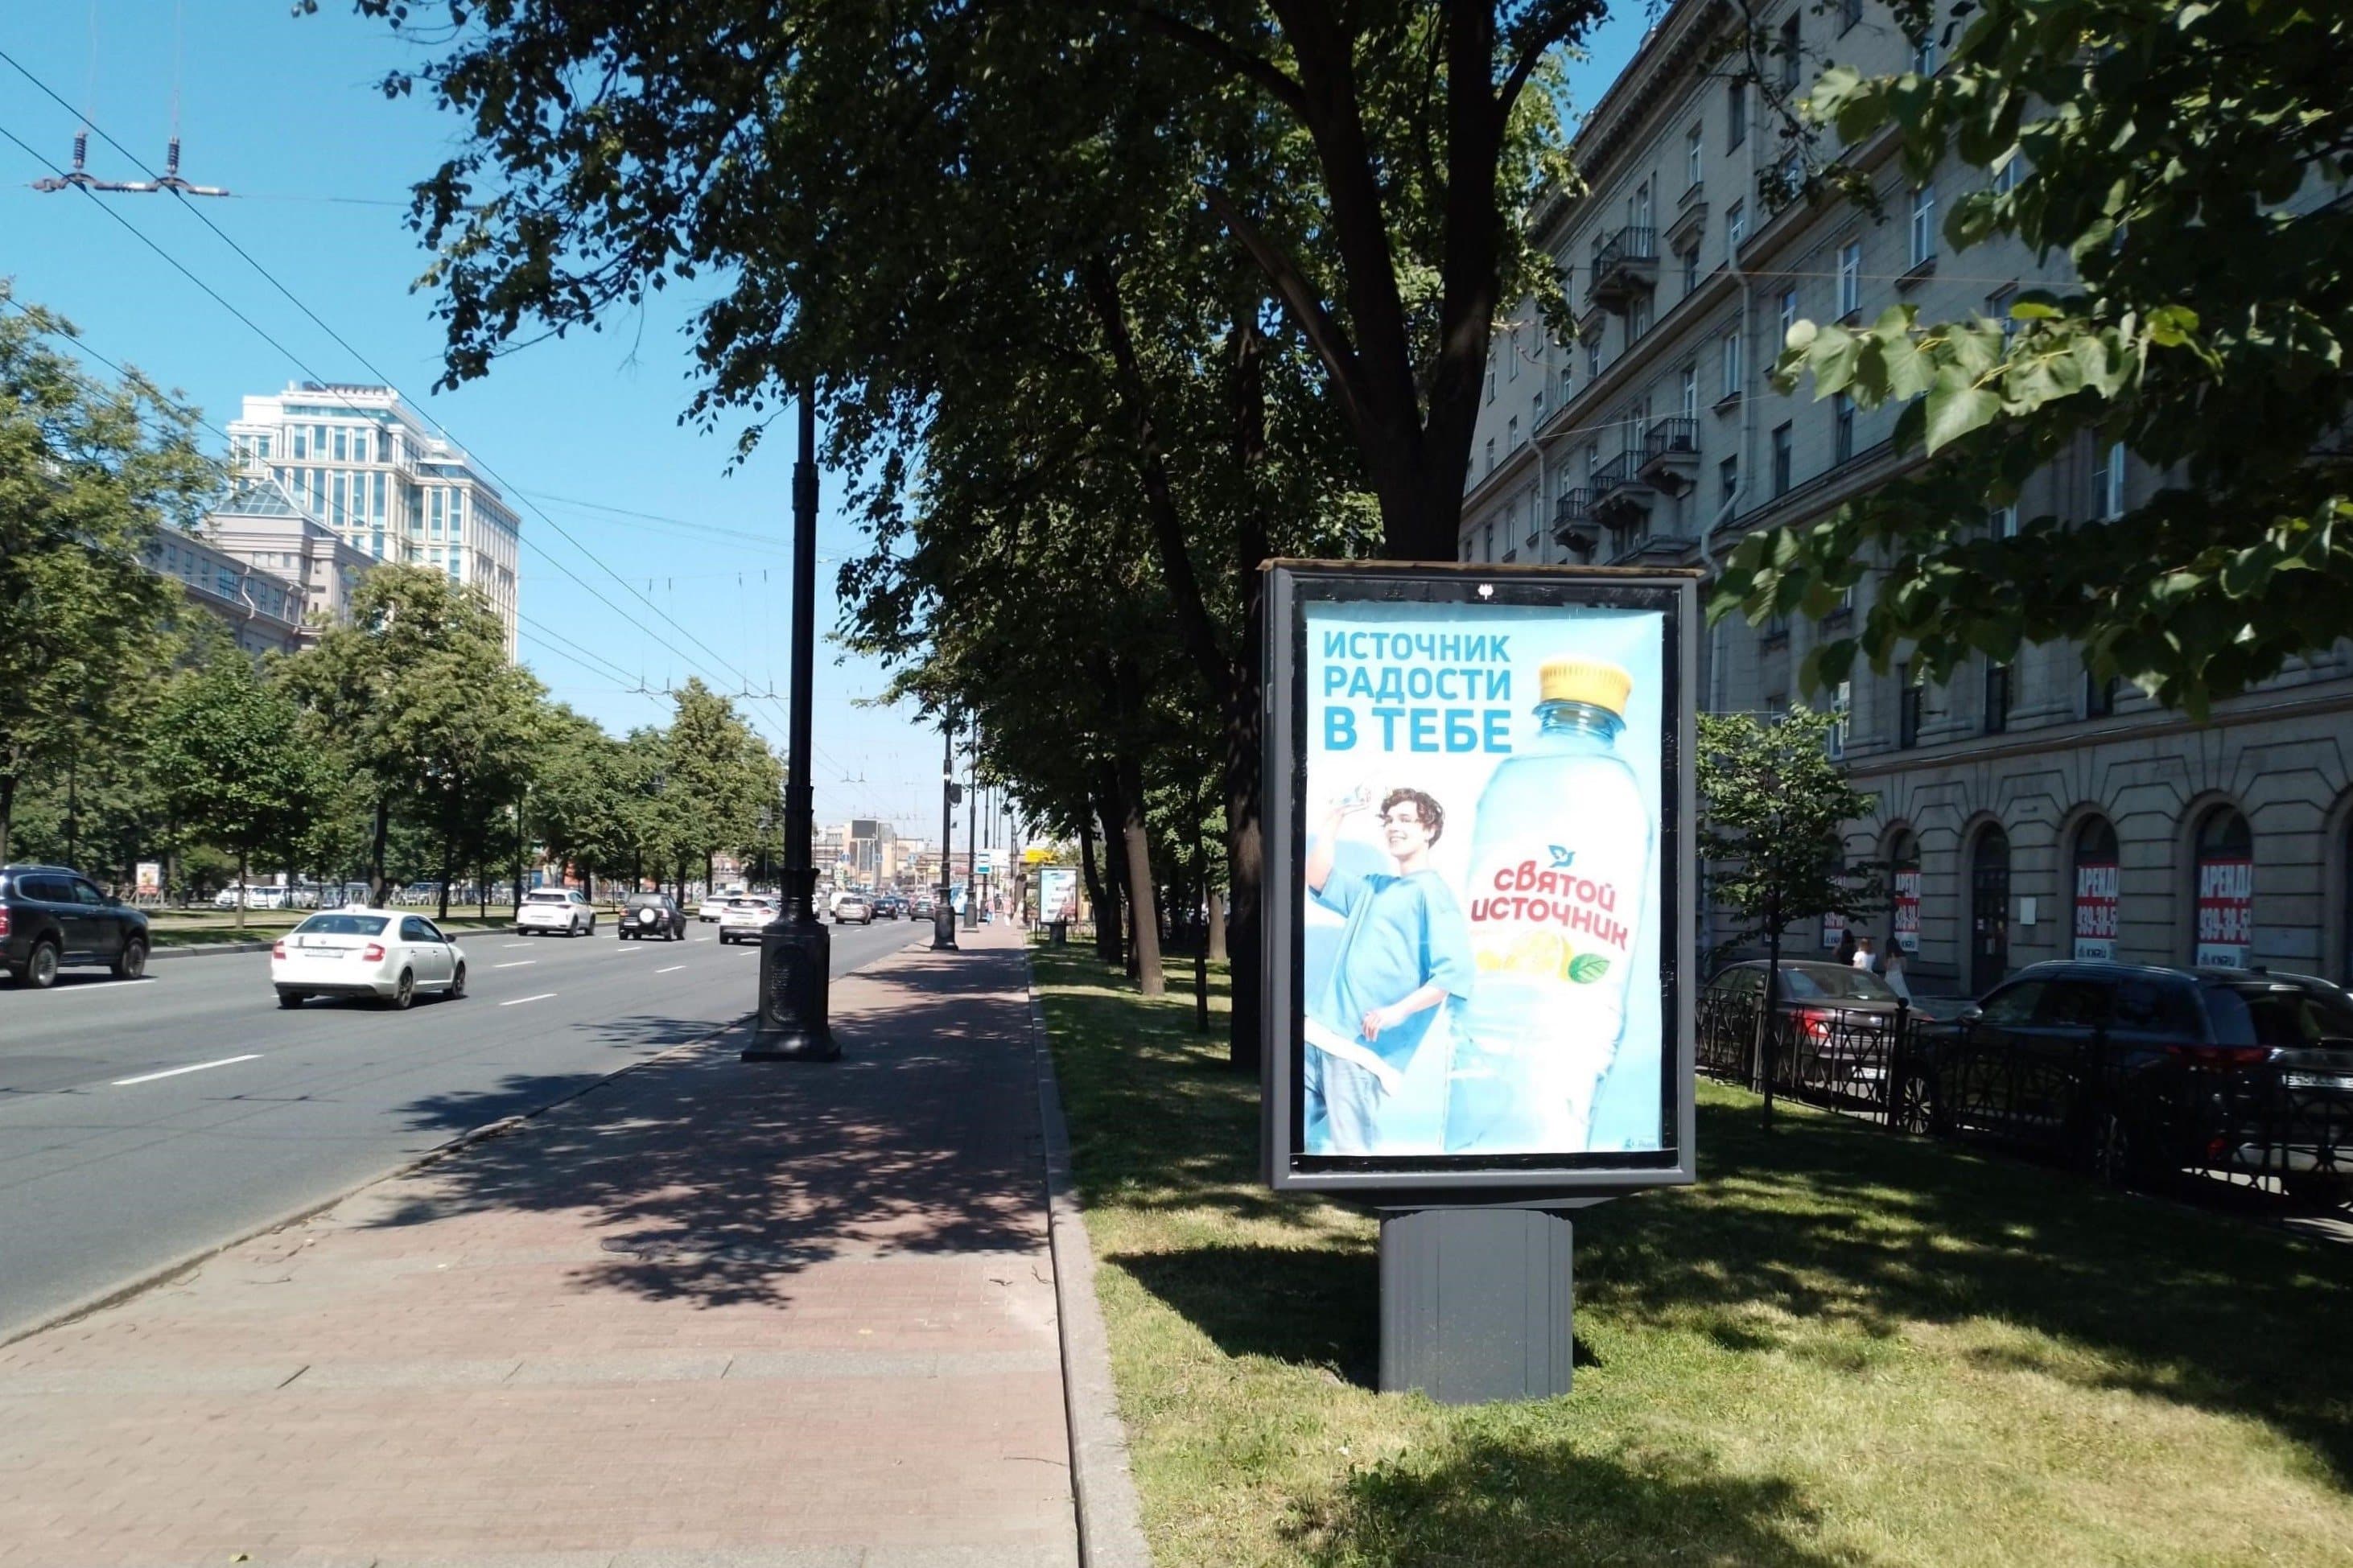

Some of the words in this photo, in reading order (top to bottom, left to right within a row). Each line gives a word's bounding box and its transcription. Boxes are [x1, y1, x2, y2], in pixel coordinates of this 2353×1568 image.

[1324, 631, 1511, 663] ИСТОЧНИК
[1324, 665, 1511, 704] РАДОСТИ
[1324, 706, 1358, 751] В
[1371, 707, 1512, 753] ТЕБЕ
